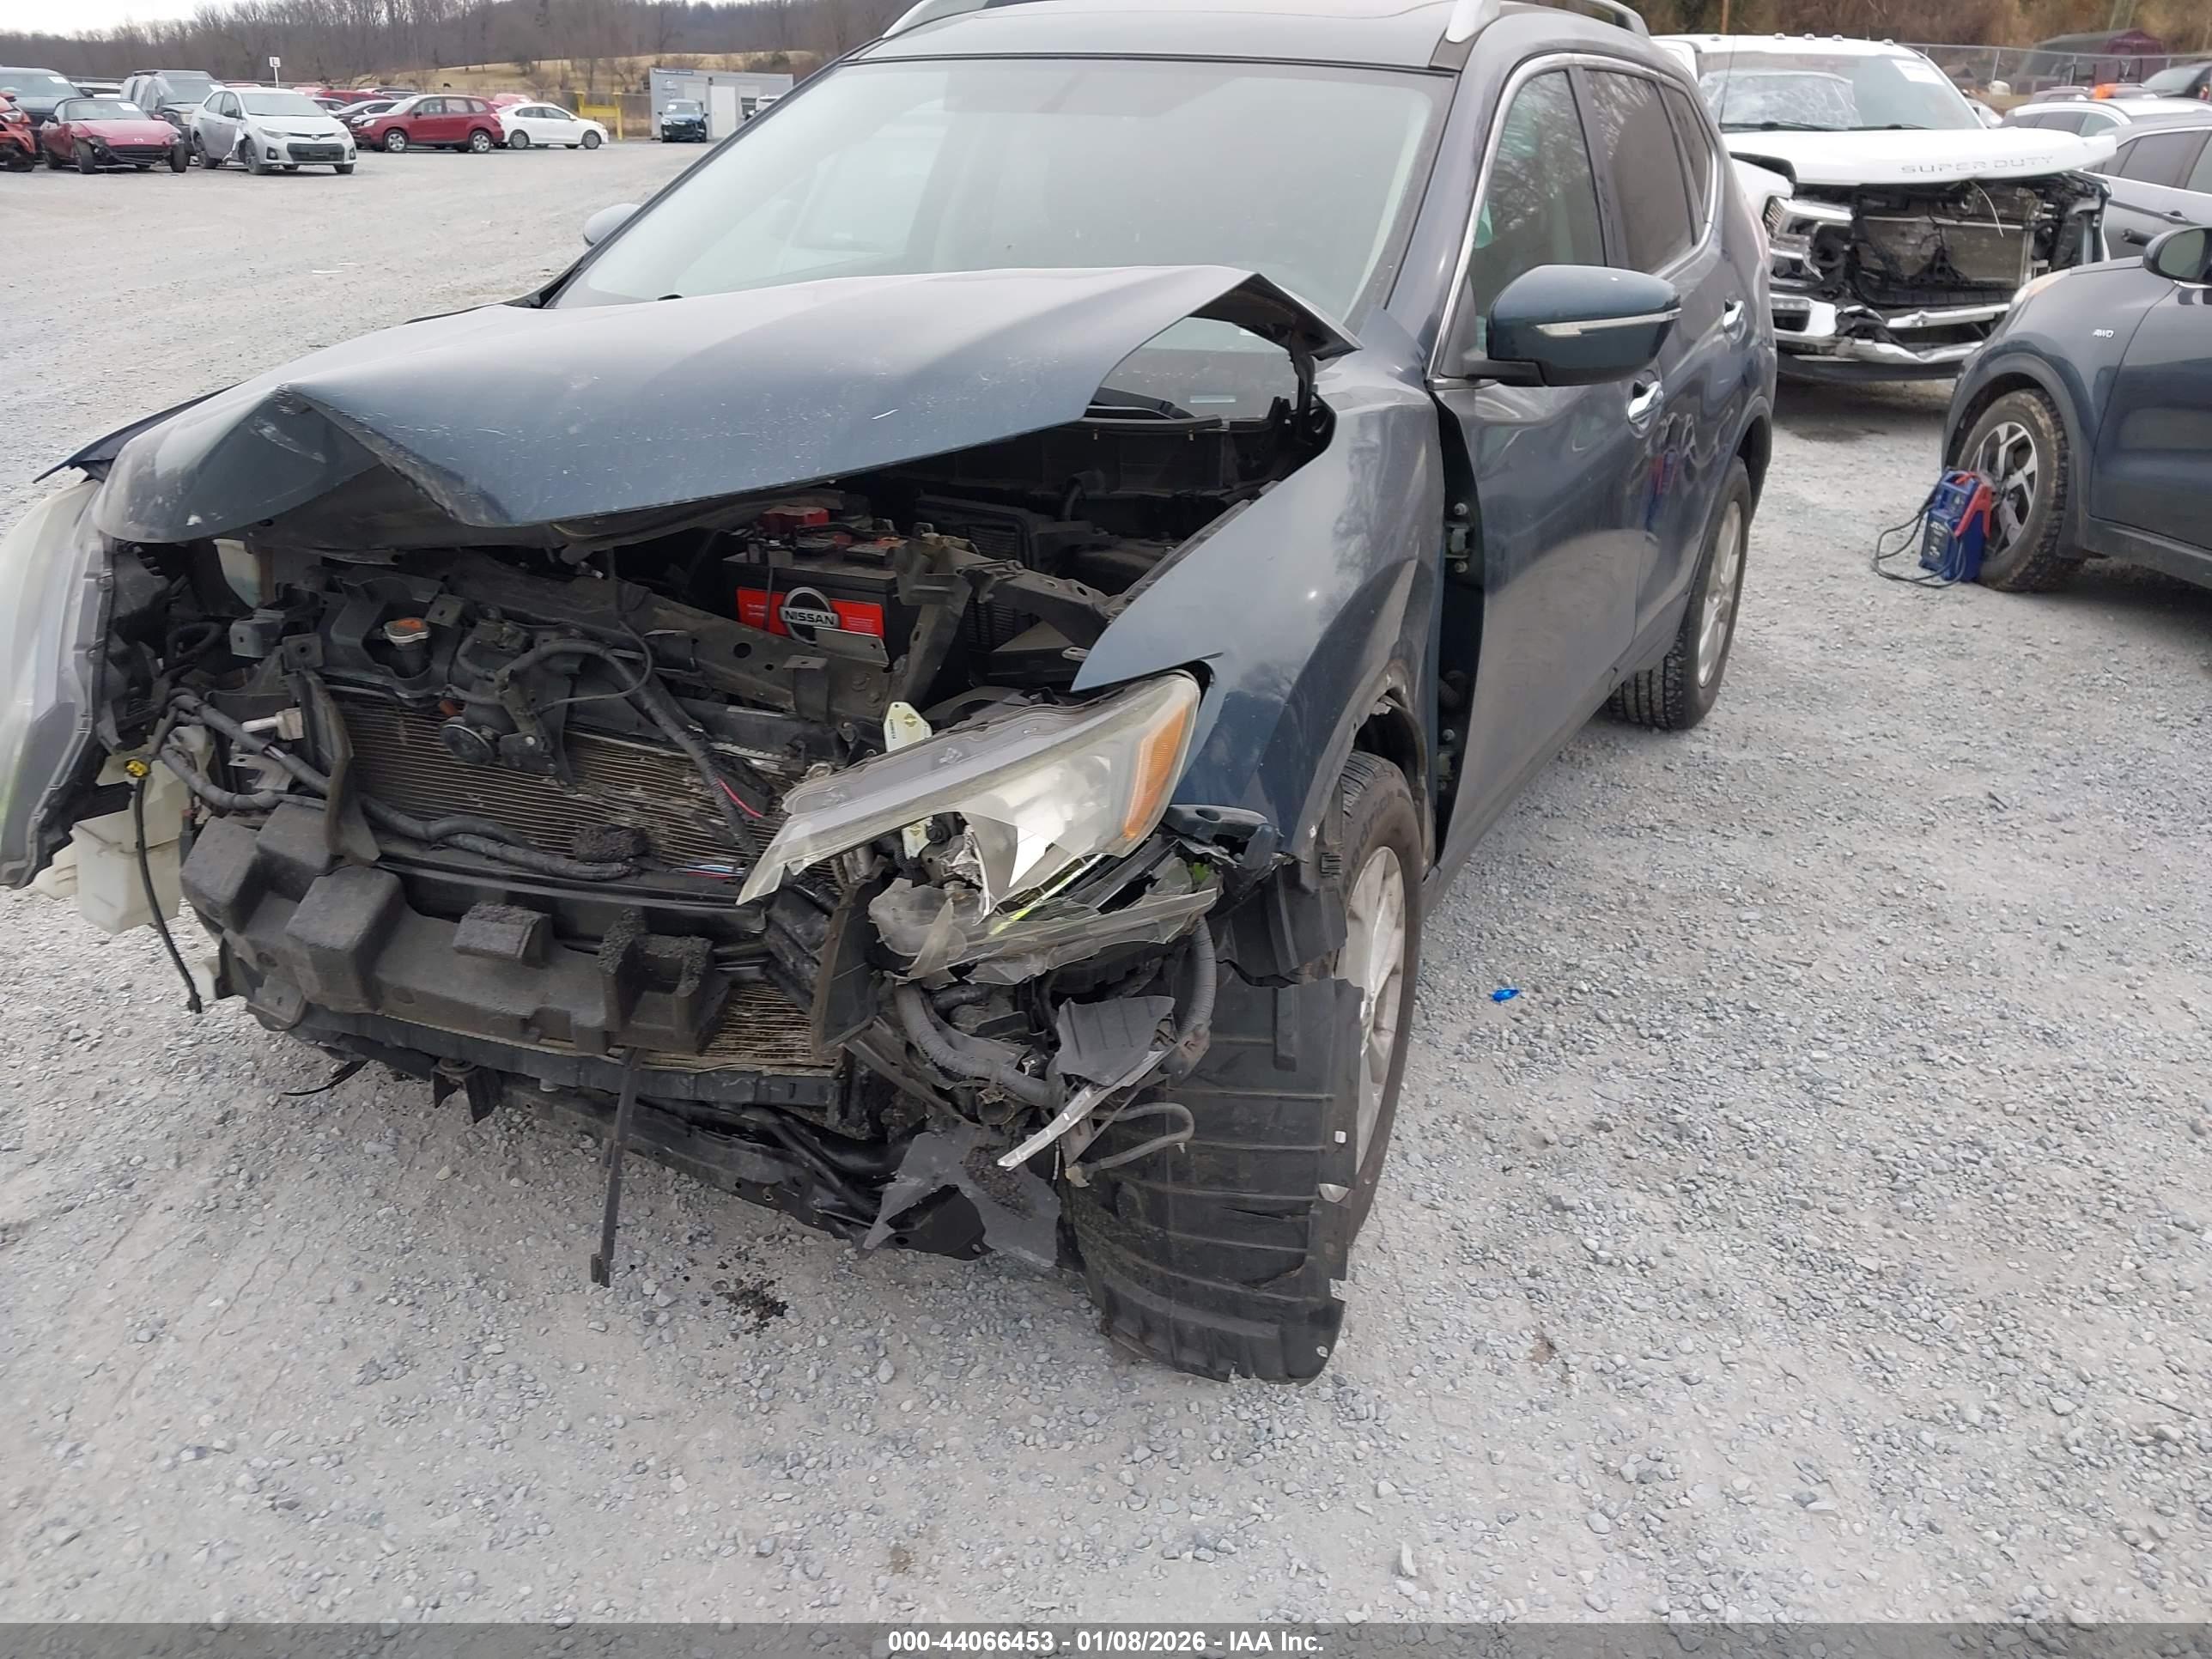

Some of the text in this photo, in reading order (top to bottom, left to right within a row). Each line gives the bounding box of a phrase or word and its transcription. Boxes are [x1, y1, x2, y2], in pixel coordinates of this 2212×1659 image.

[1900, 155, 2054, 173] SUPER DUTY
[784, 610, 835, 626] NISSAN
